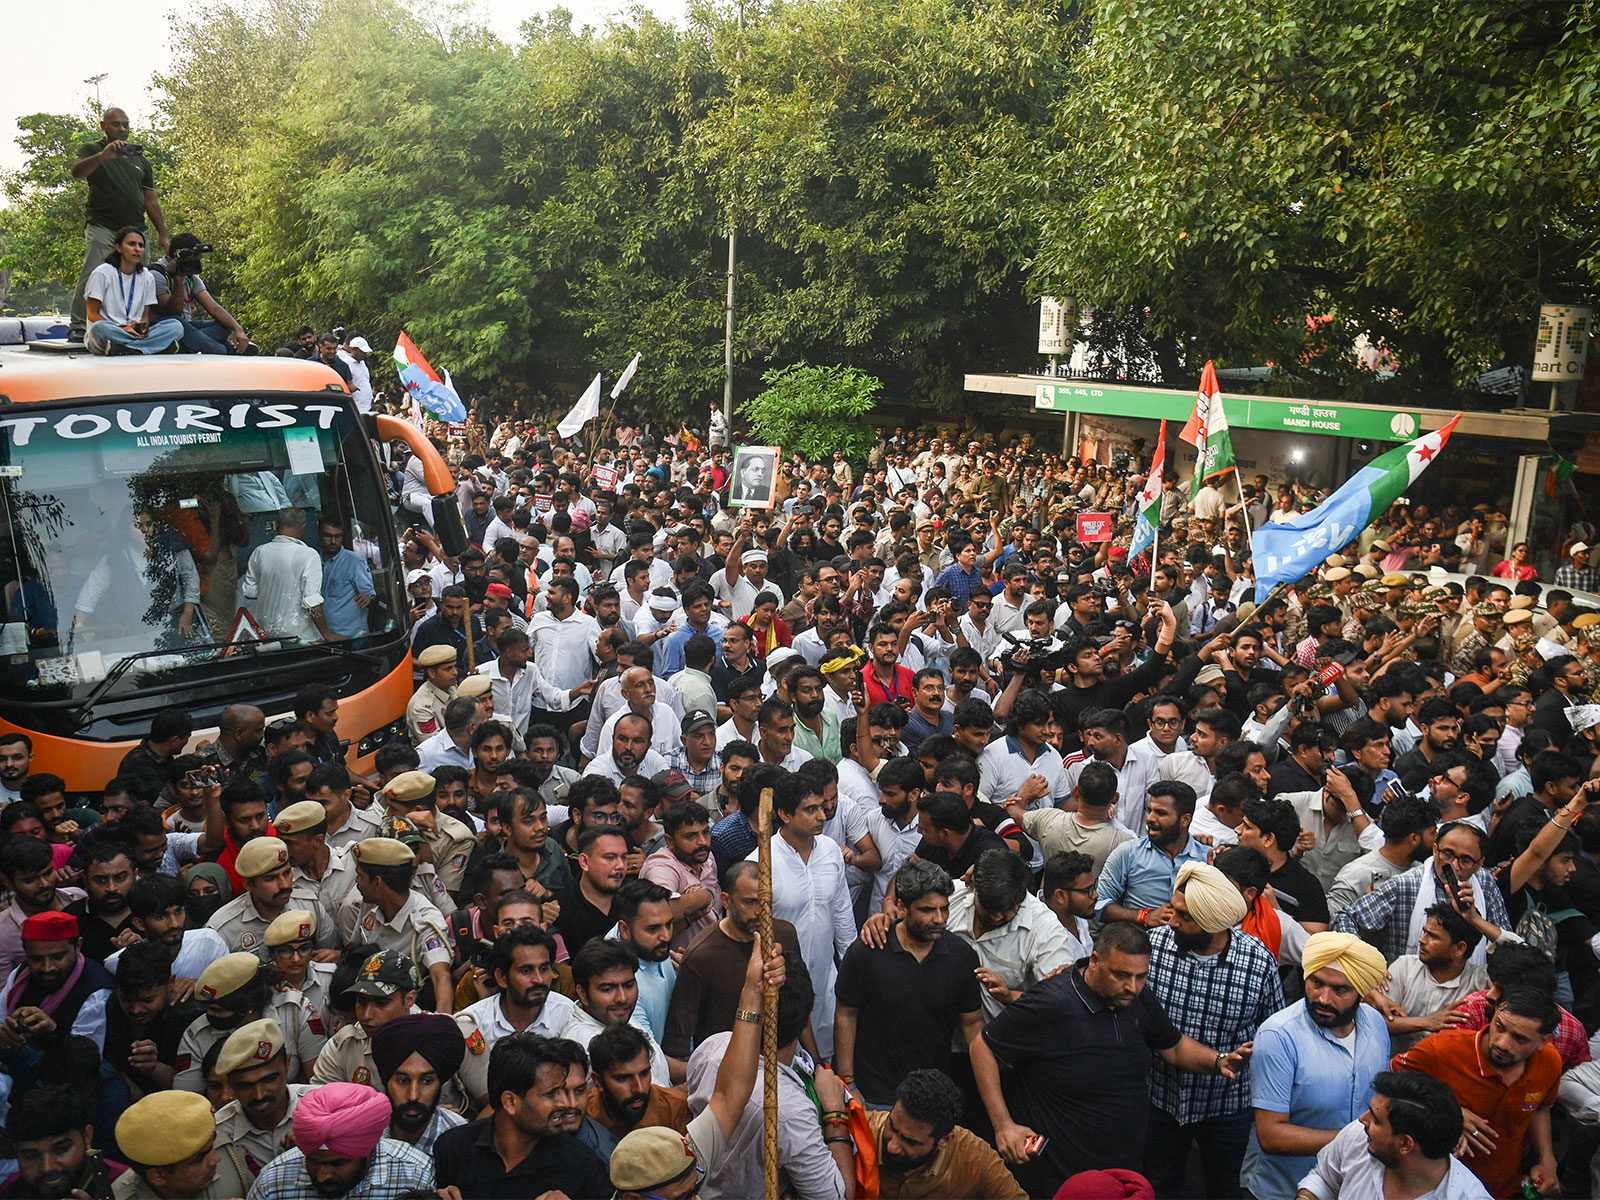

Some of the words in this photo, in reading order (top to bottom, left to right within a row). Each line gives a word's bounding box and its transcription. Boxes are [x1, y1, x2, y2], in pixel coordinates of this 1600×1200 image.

[1533, 361, 1562, 373] mart
[1058, 387, 1072, 395] 355,
[1074, 388, 1088, 397] 445,
[1091, 389, 1103, 397] LTD
[1288, 405, 1310, 416] मण्डी
[1312, 407, 1338, 419] हाउस
[0, 403, 344, 446] TOURIST
[1283, 417, 1310, 427] MANDI
[1311, 420, 1341, 430] HOUSE
[136, 436, 150, 447] ALL
[150, 435, 169, 446] INDIA
[169, 434, 197, 445] TOURIST
[197, 432, 222, 443] PERMIT
